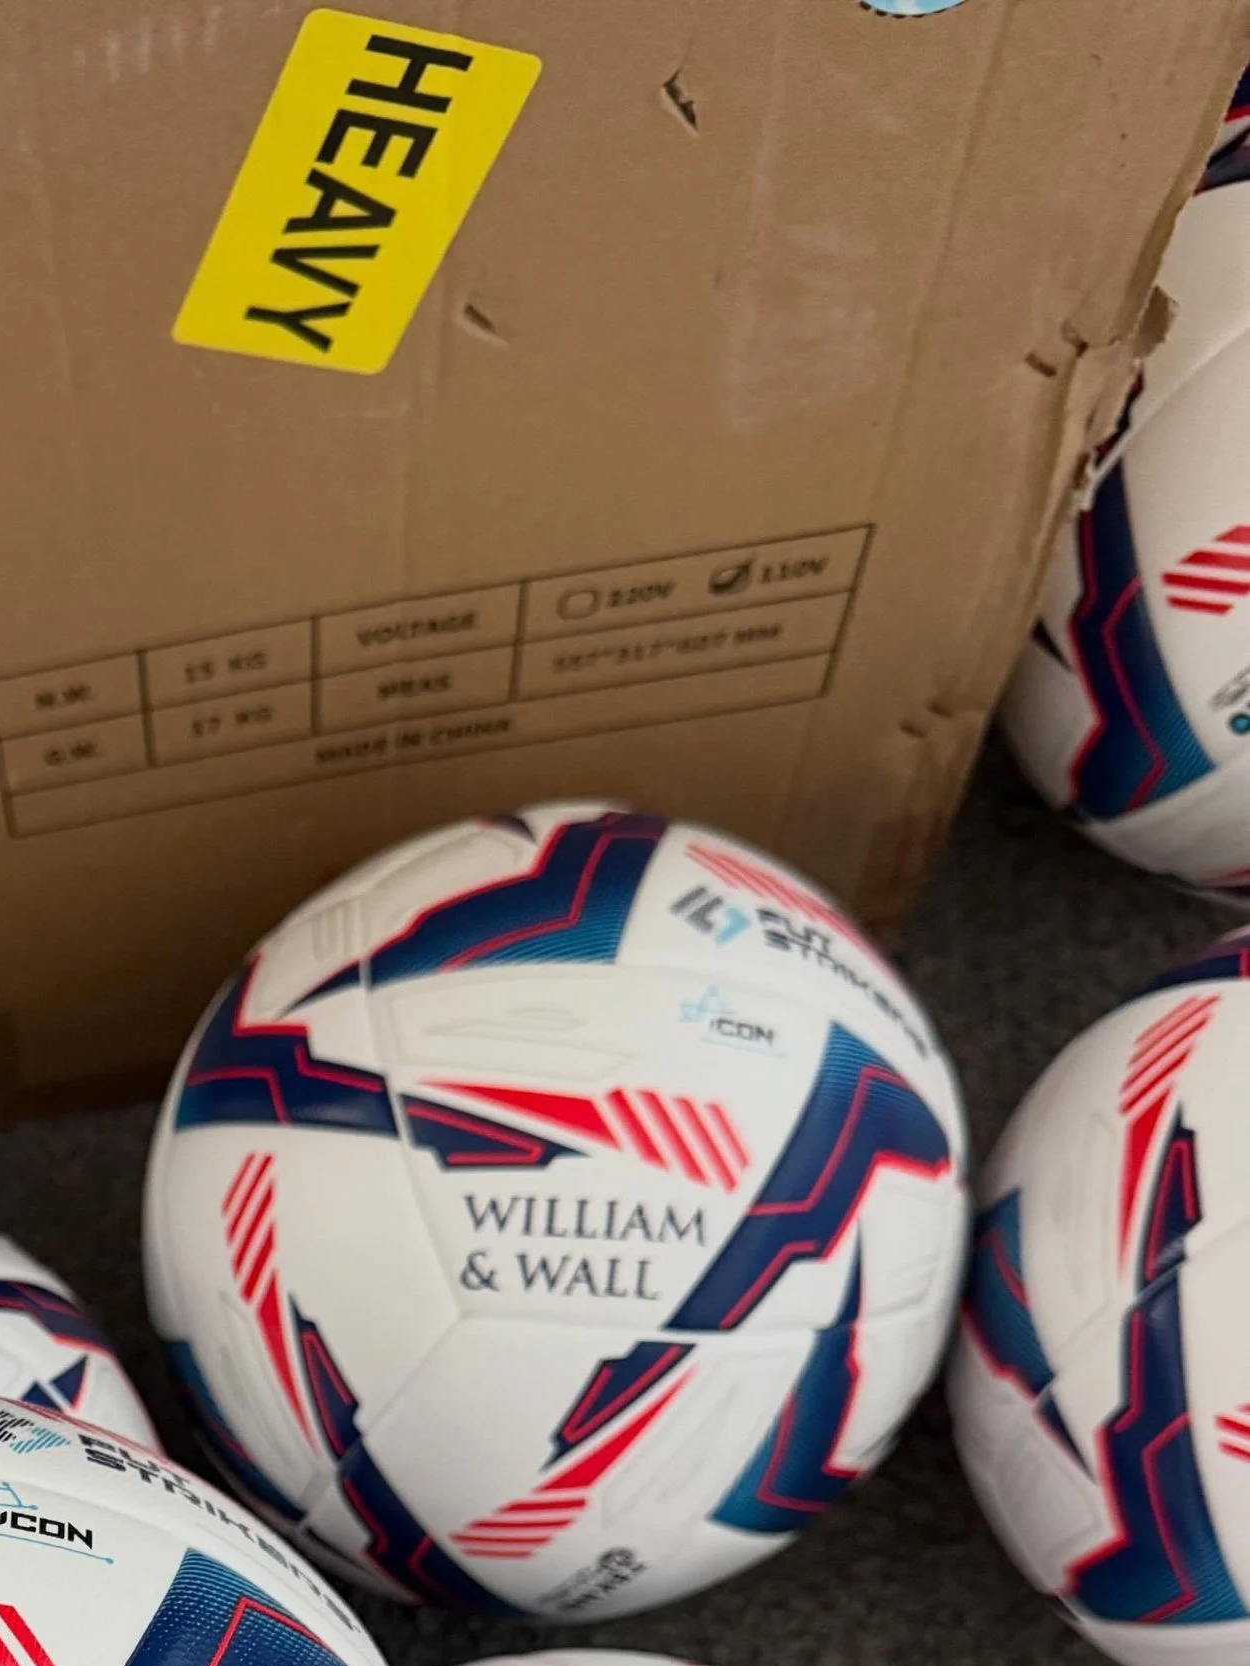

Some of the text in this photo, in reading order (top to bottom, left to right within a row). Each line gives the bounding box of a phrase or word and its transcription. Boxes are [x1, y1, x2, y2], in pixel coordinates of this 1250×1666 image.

[244, 34, 474, 353] HEAVY
[759, 556, 830, 584] 110V
[356, 611, 476, 647] VOLTAGE
[228, 650, 268, 674] KG
[233, 704, 274, 728] KG
[315, 717, 513, 765] MADE IN CHINA
[462, 1194, 707, 1248] WILLIAM
[458, 1249, 661, 1302] & WALL
